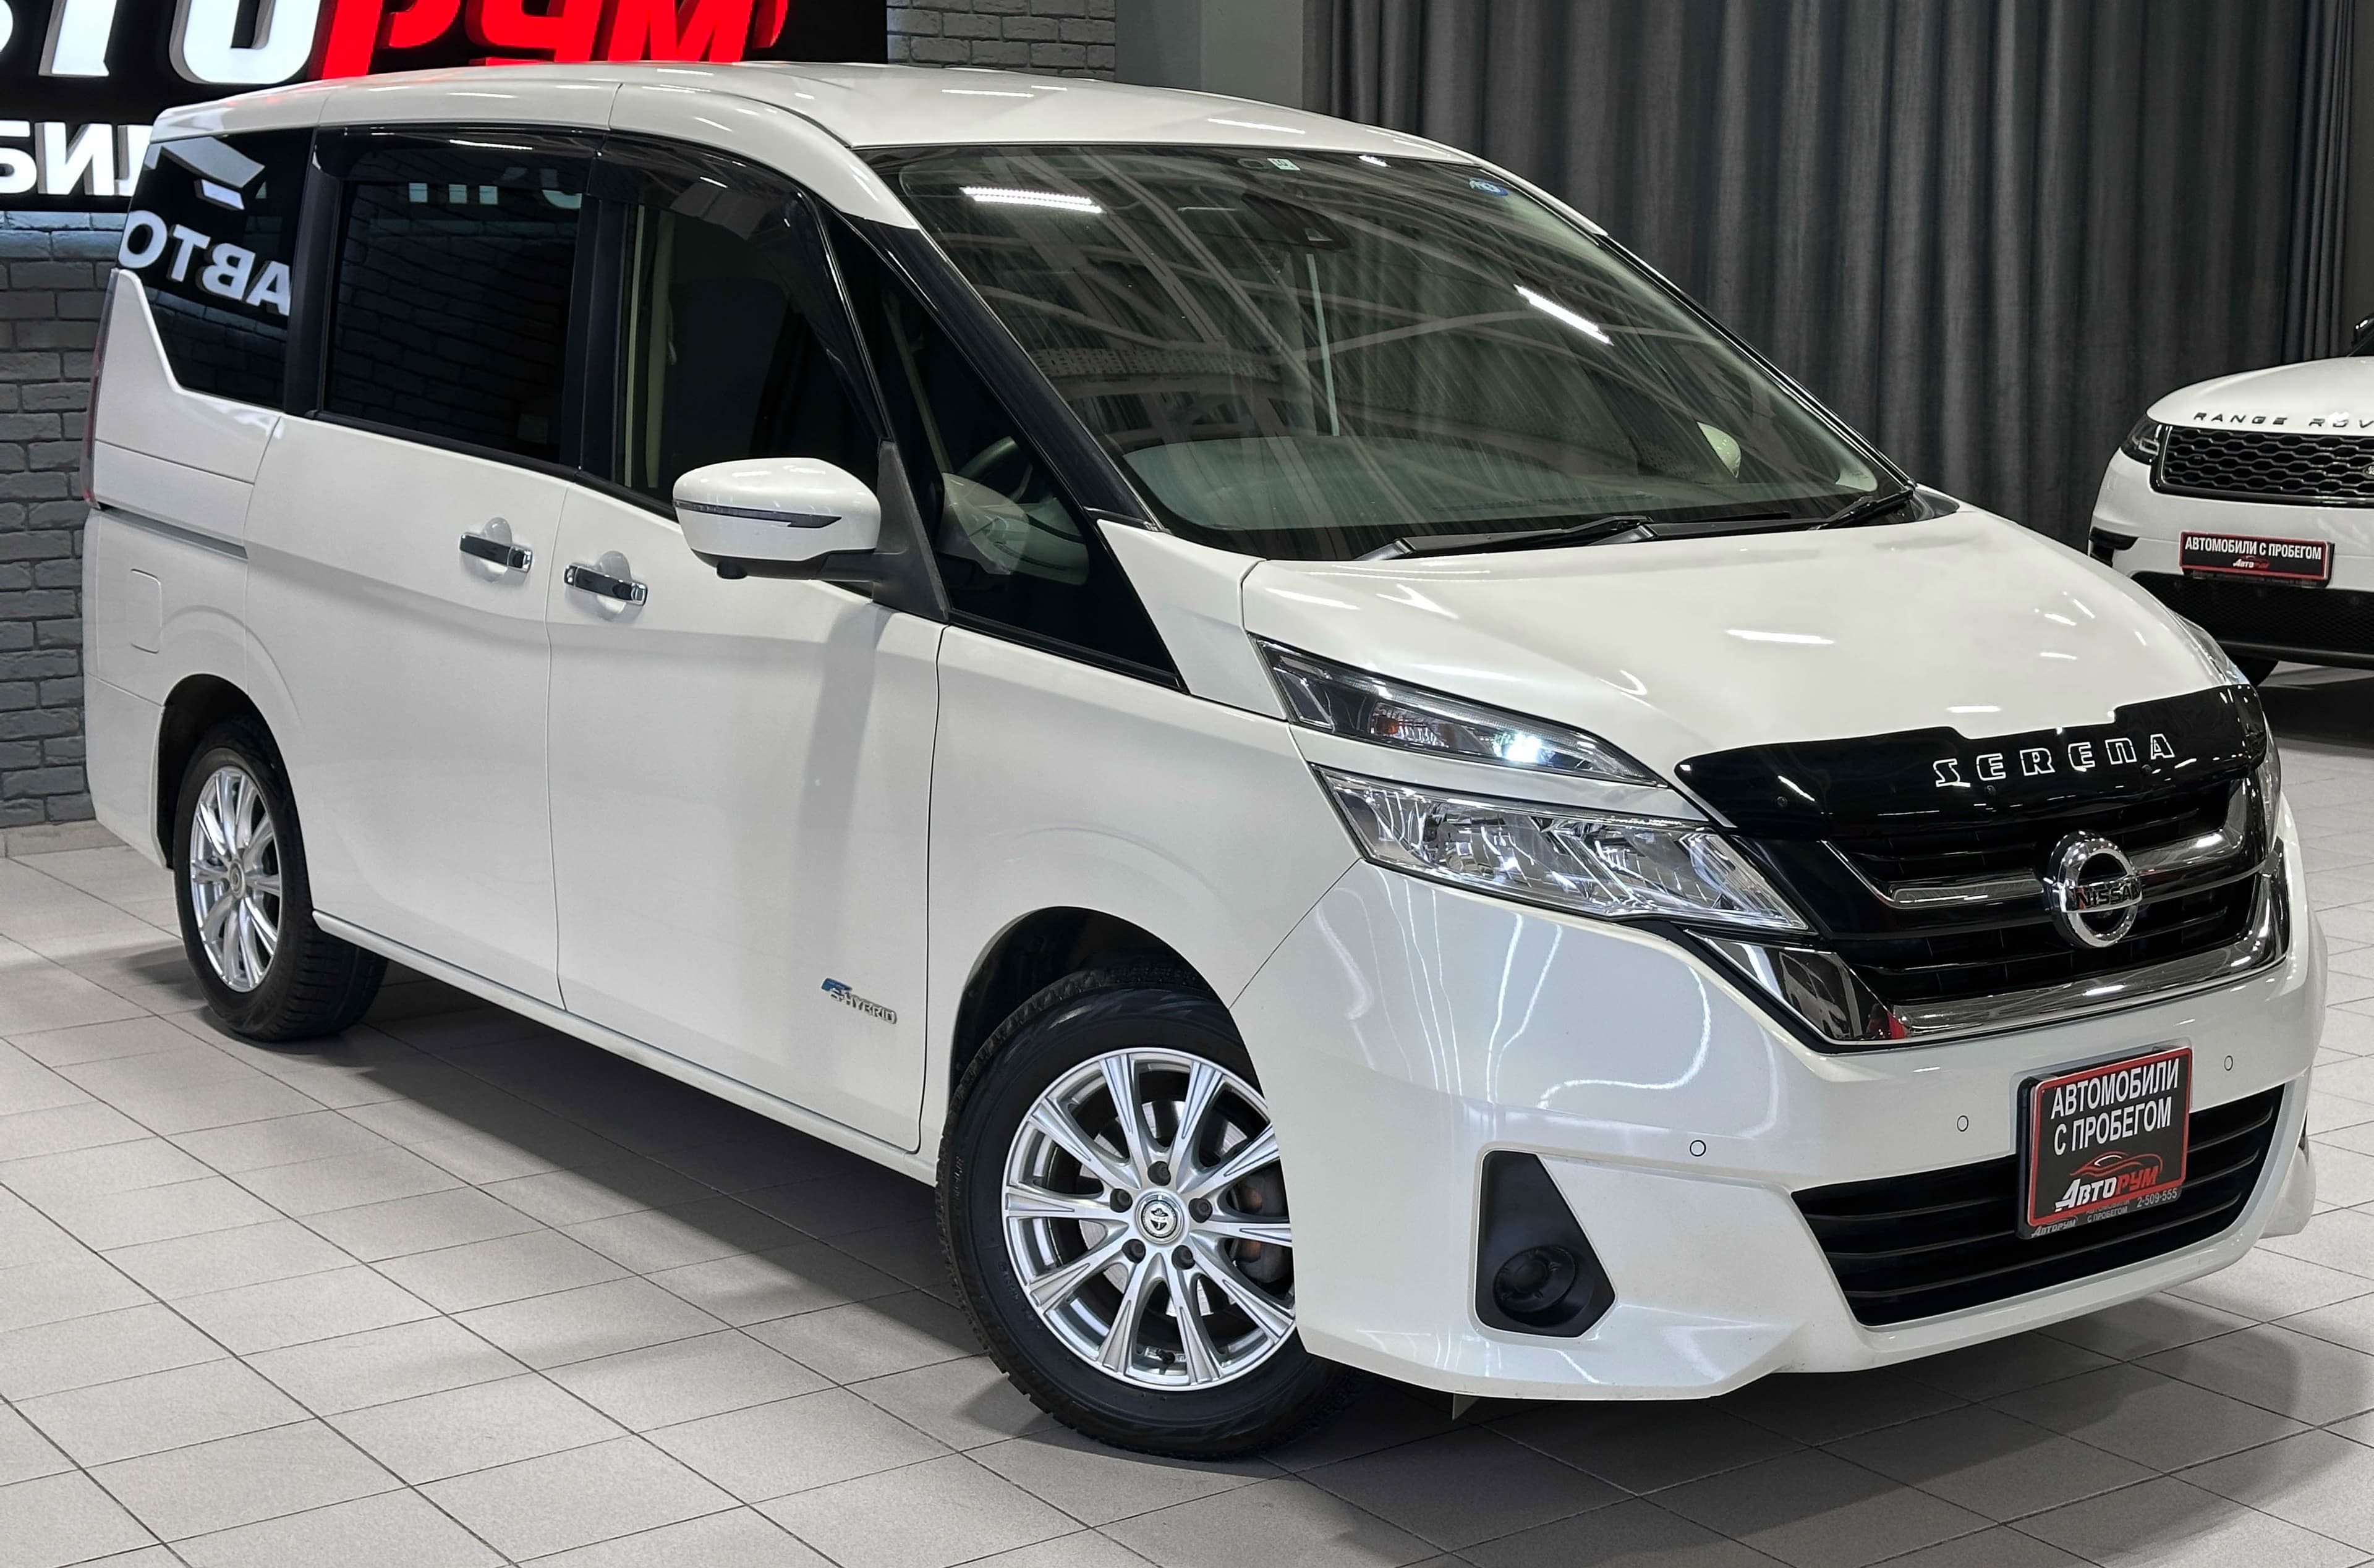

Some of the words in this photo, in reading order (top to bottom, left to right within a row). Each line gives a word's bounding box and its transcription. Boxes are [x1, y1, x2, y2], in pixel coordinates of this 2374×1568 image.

[2193, 412, 2287, 425] RANGE
[2185, 536, 2257, 554] АВТОМОБИЛИ
[2259, 543, 2266, 556] С
[2268, 543, 2322, 559] ПРОБЕГОМ
[1933, 734, 2175, 787] SERENA
[2075, 881, 2140, 910] NISSAN
[2050, 1058, 2179, 1119] АВТОМОБИЛИ
[2054, 1124, 2067, 1155] С
[2071, 1096, 2172, 1151] ПРОБЕГОМ
